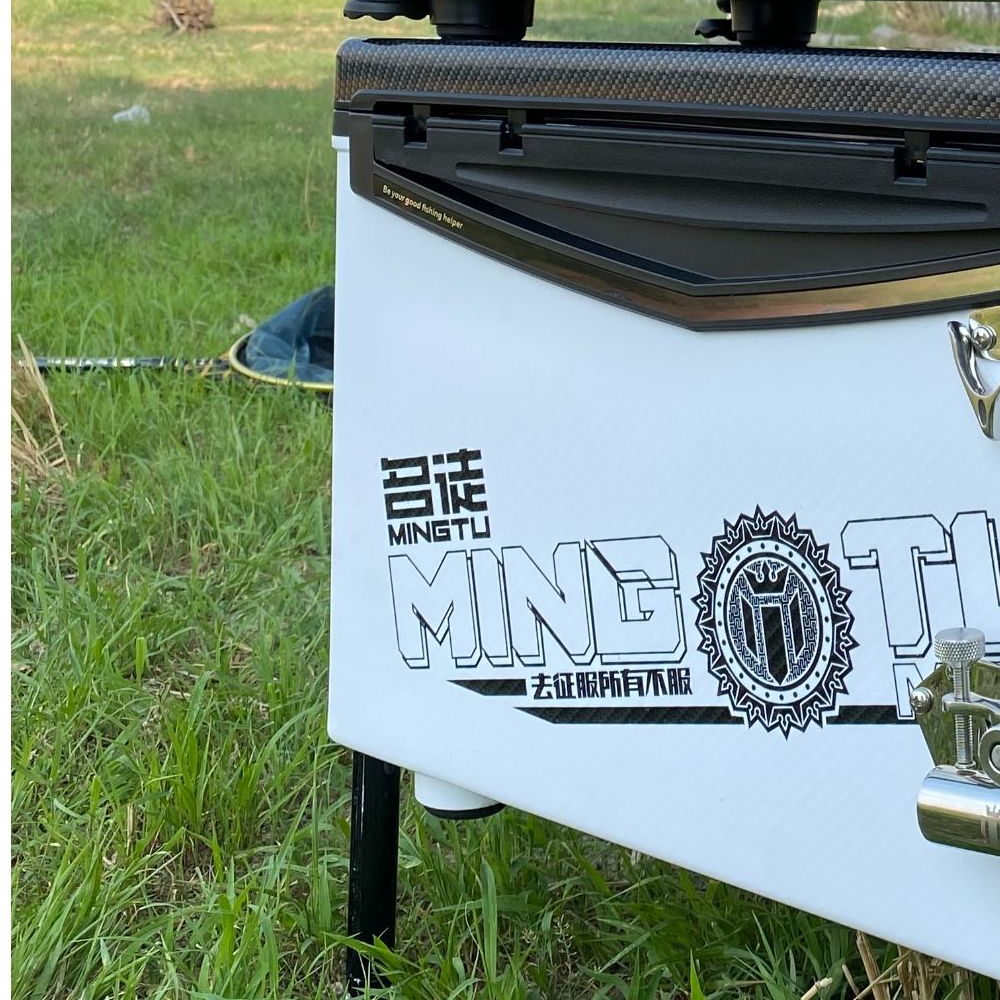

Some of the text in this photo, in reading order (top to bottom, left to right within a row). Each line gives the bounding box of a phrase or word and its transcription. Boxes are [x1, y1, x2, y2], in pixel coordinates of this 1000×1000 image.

[382, 184, 463, 229] Be your good fishing helper
[388, 516, 491, 546] MINGTU
[388, 535, 688, 669] MING
